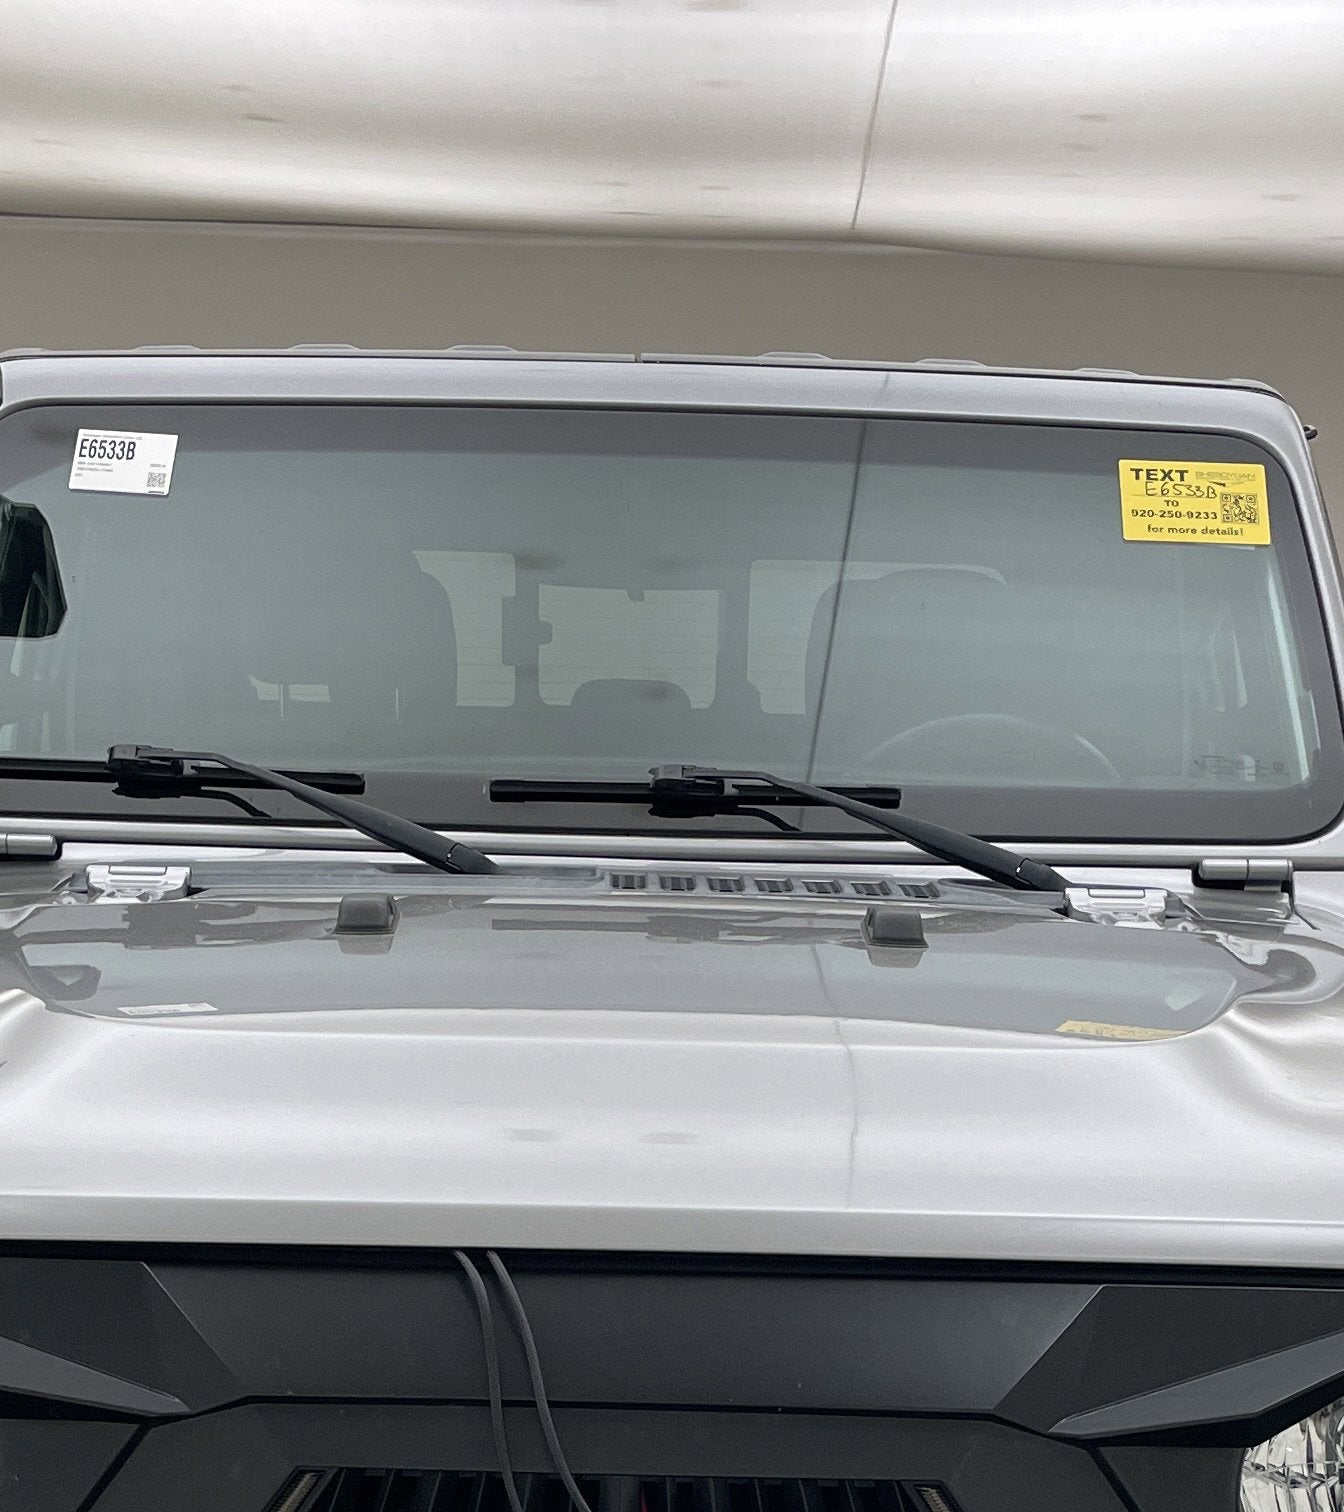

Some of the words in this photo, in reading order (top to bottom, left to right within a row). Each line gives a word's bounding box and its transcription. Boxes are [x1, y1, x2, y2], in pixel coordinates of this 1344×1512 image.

[78, 438, 137, 460] E6533B
[1130, 468, 1189, 482] TEXT
[1145, 481, 1218, 499] E6533B
[1147, 524, 1164, 533] for
[1167, 527, 1197, 535] more
[1201, 525, 1244, 536] details!
